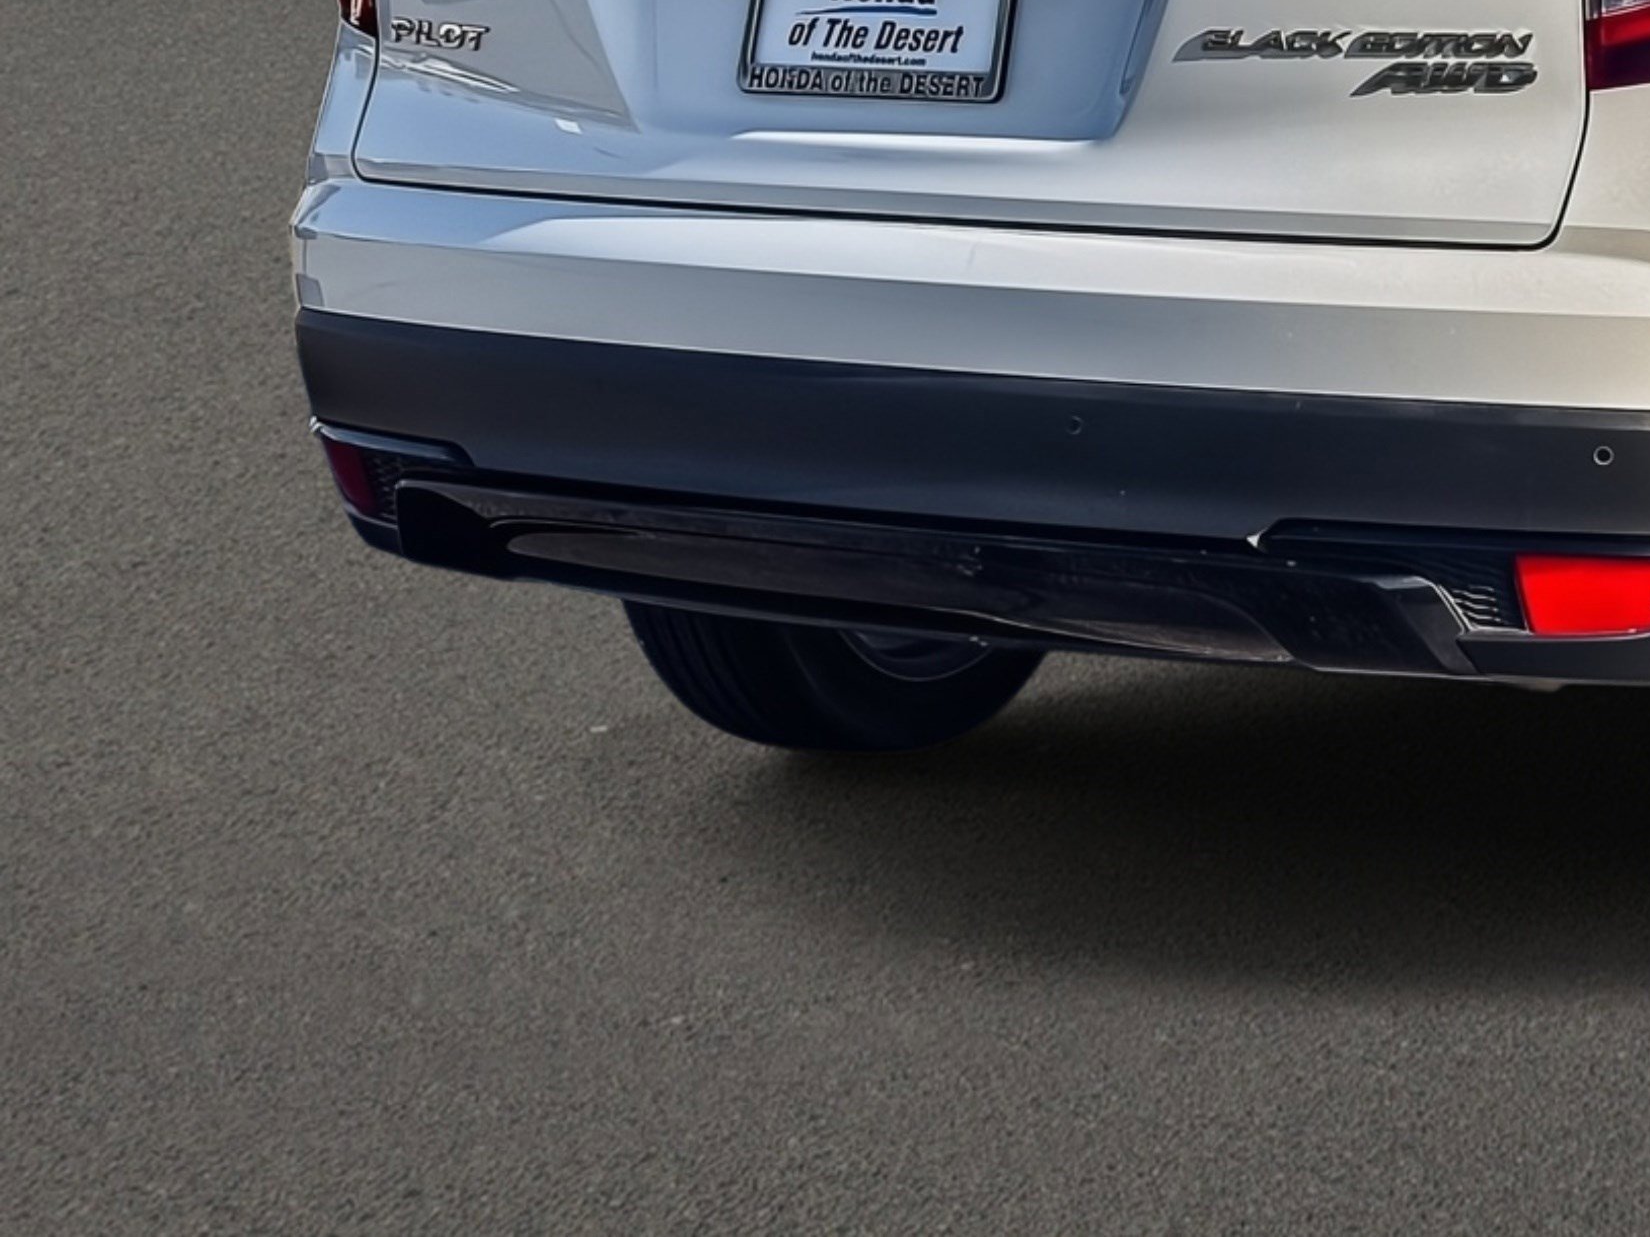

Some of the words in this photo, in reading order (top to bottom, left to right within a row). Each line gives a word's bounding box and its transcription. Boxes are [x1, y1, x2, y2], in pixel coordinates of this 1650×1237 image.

[391, 17, 490, 51] PILOT
[788, 17, 817, 47] of
[822, 18, 869, 50] The
[873, 21, 964, 54] Desert
[1172, 29, 1352, 62] BLACK
[1344, 31, 1533, 60] EDITION
[750, 66, 823, 92] HONDA
[830, 71, 851, 92] of
[858, 71, 890, 93] the
[901, 73, 984, 99] DESERT
[1350, 62, 1538, 98] AWD
